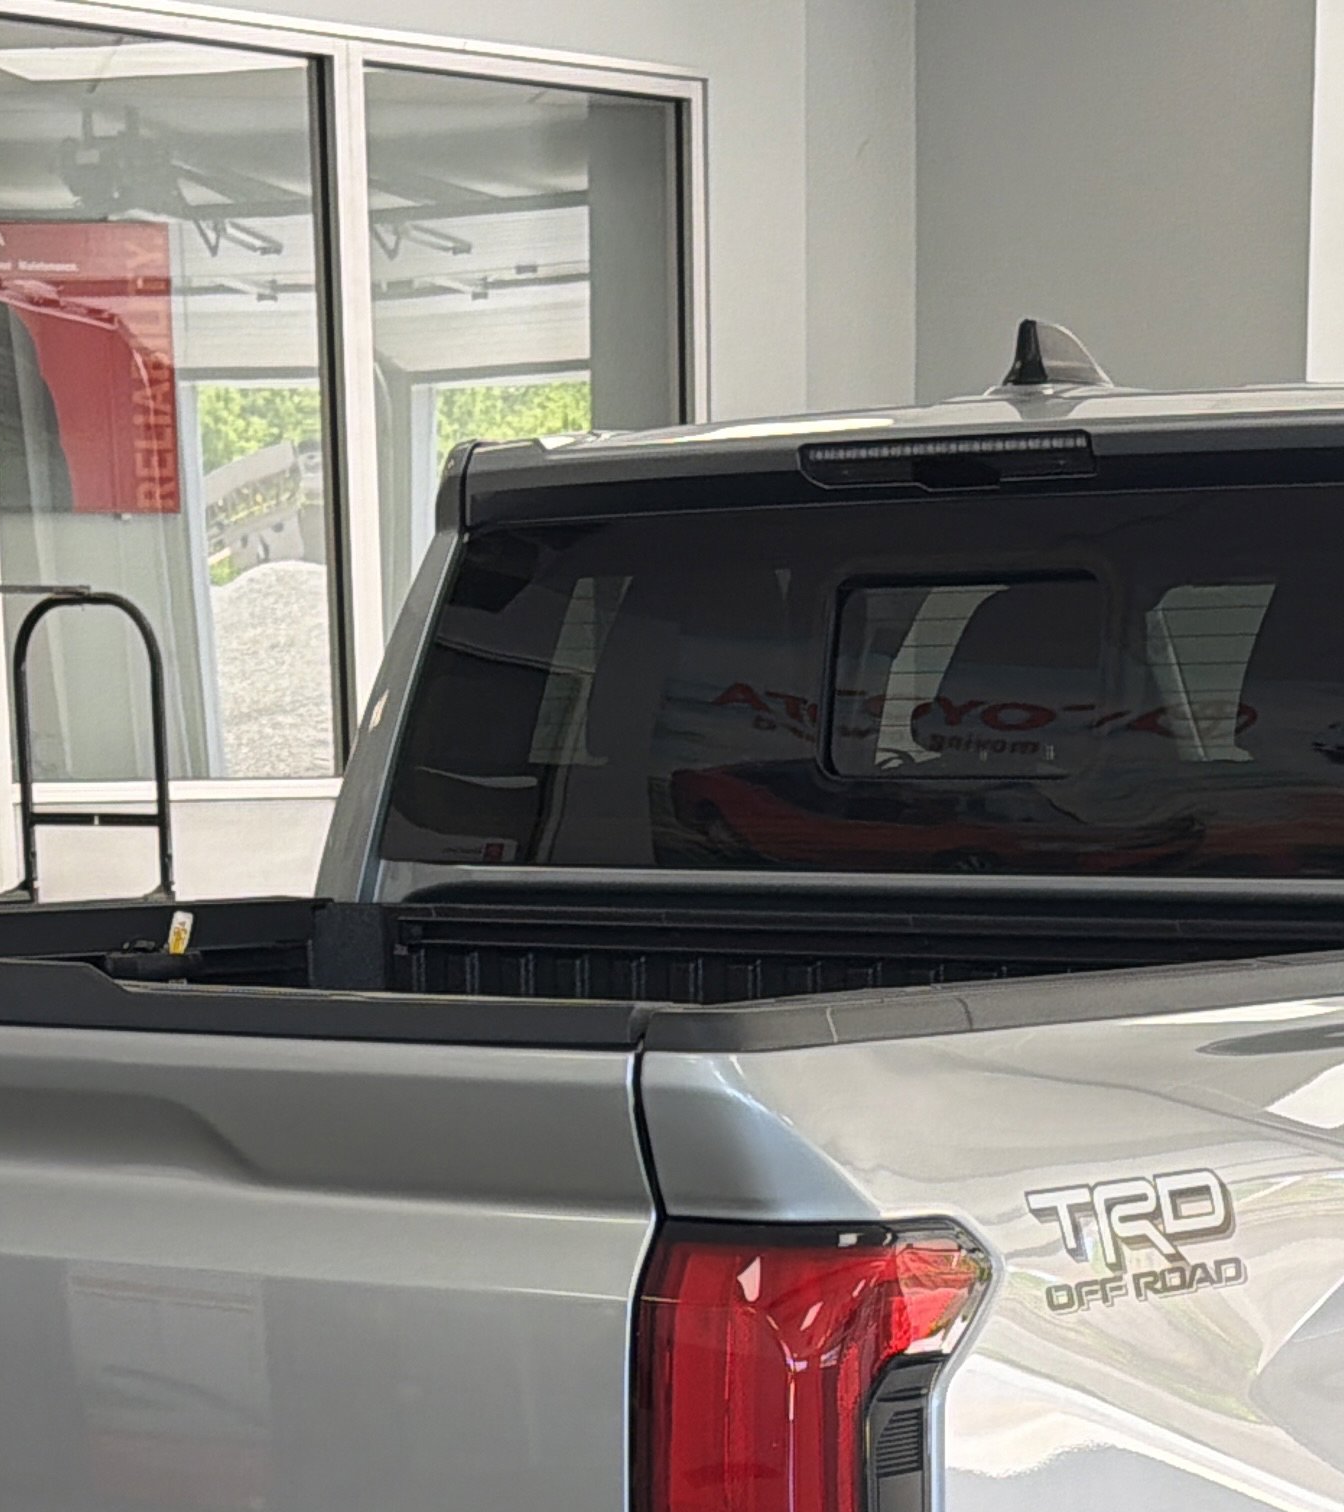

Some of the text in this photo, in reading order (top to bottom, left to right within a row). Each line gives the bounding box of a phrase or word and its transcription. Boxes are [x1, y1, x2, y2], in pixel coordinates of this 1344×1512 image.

[1024, 1168, 1235, 1273] TRD
[1046, 1256, 1248, 1315] OFF ROAD
